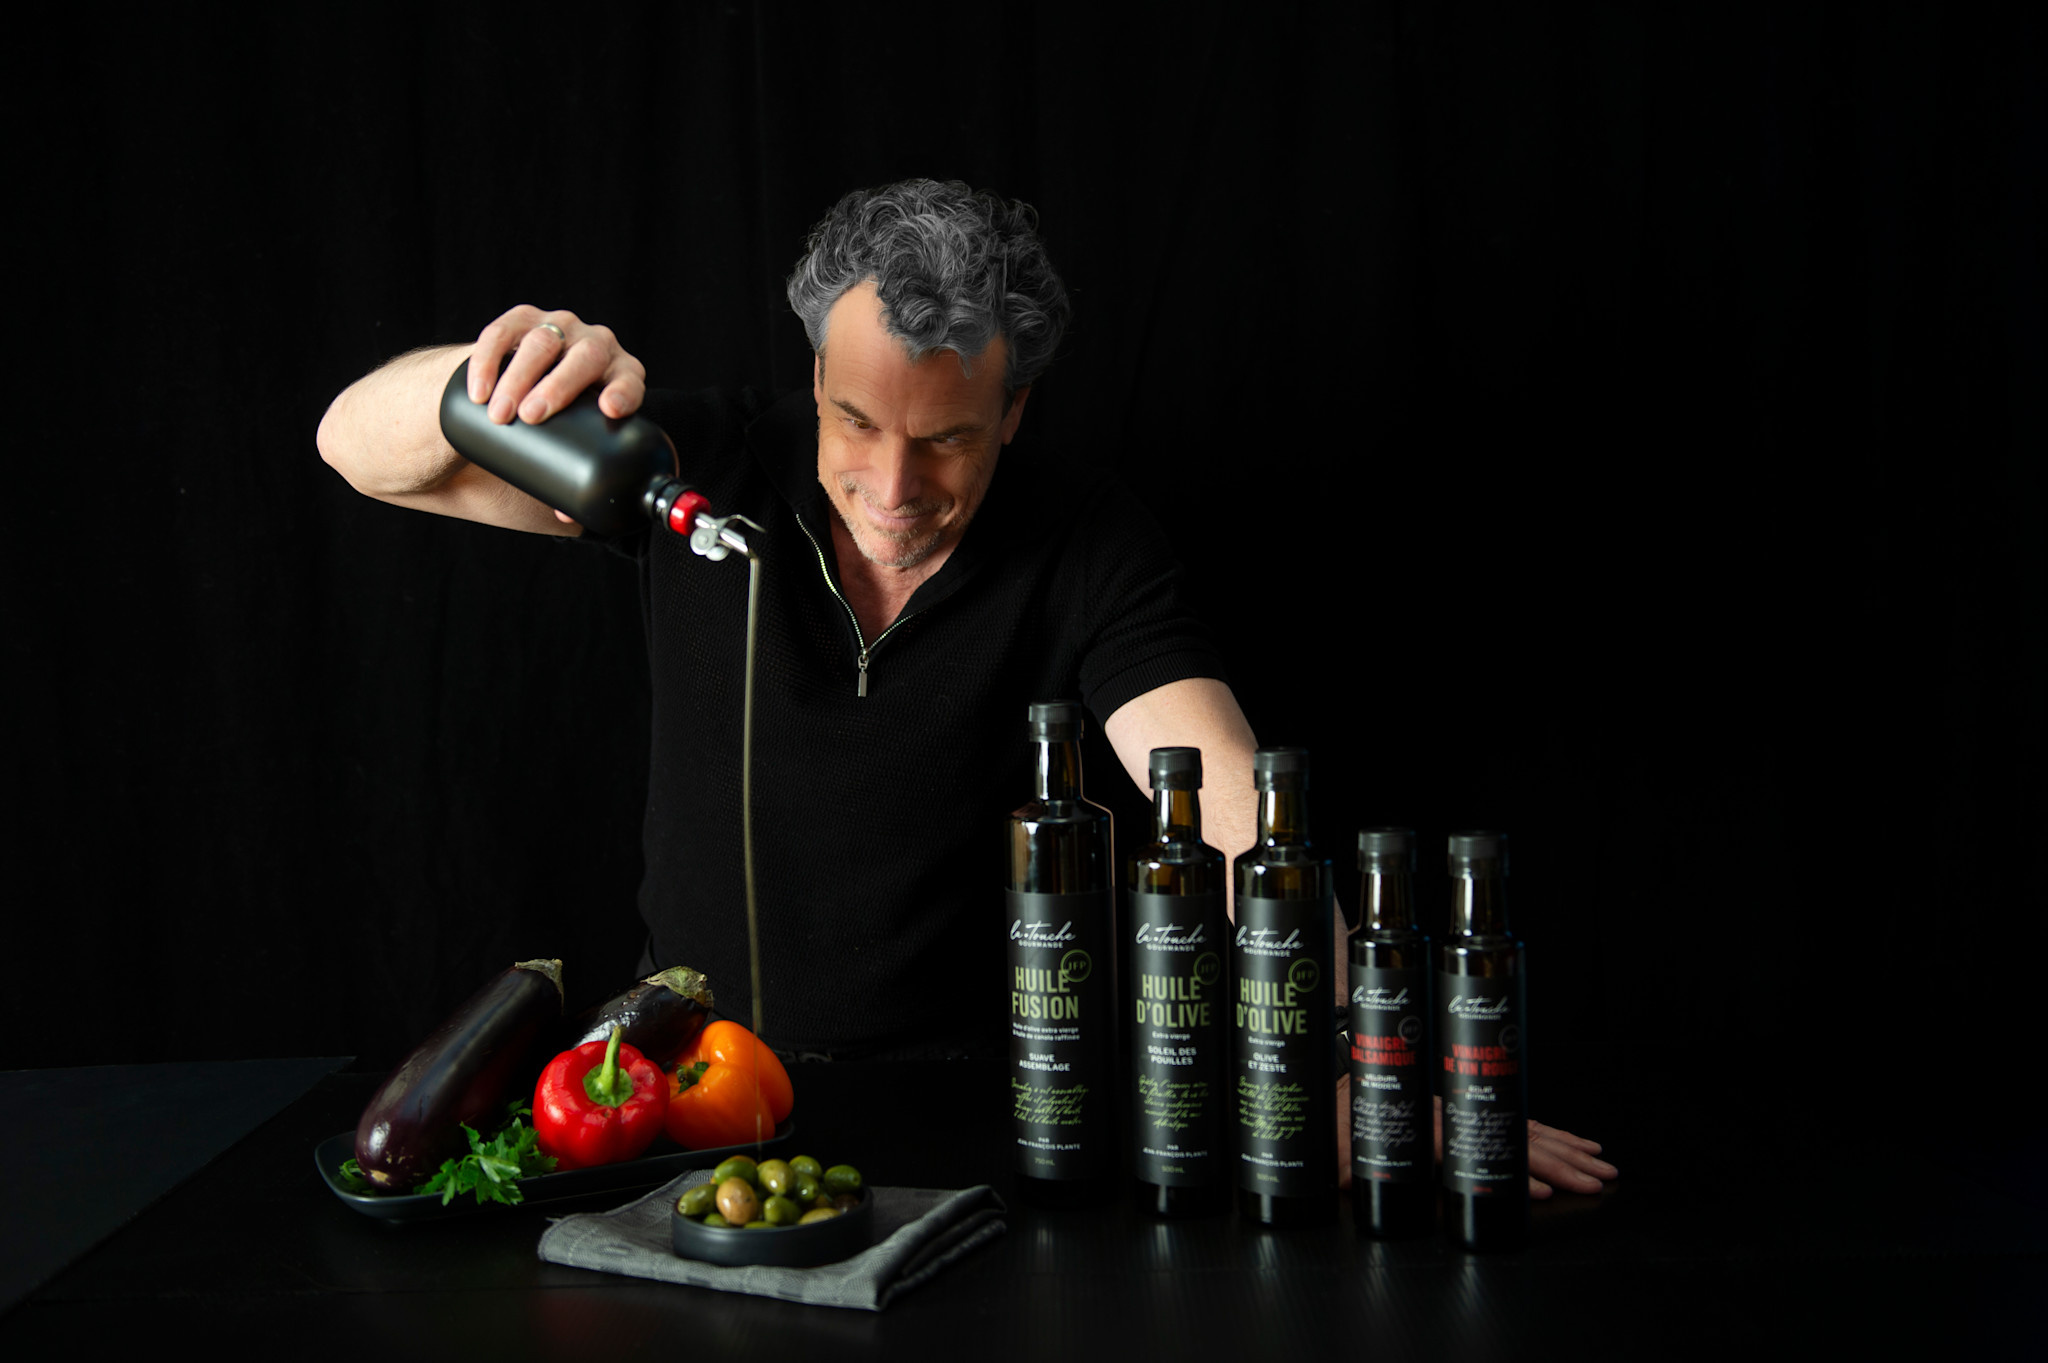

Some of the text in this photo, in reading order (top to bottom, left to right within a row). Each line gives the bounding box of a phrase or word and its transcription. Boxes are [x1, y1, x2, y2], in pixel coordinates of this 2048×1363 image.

[1018, 940, 1063, 949] GOURMANDE
[1067, 961, 1087, 971] JFP
[1015, 965, 1071, 993] HUILE
[1142, 973, 1202, 1001] HUILE
[1240, 977, 1298, 1007] HUILE
[1012, 991, 1079, 1020] FUSION
[1136, 998, 1211, 1028] D'OLIVE
[1236, 1002, 1308, 1035] D'OLIVE
[1058, 1027, 1079, 1035] vierge
[1148, 1045, 1197, 1056] SOLEIL DES
[1351, 1045, 1416, 1067] BALSAMIQUE
[1029, 1052, 1055, 1062] SUAVE
[1151, 1055, 1193, 1066] POUILLES
[1253, 1052, 1279, 1063] OLIVE
[1019, 1059, 1071, 1072] ASSEMBLAGE
[1248, 1060, 1258, 1070] ET
[1443, 1056, 1455, 1073] DE
[1457, 1060, 1479, 1076] VIN
[1056, 1143, 1081, 1151] PLANTE
